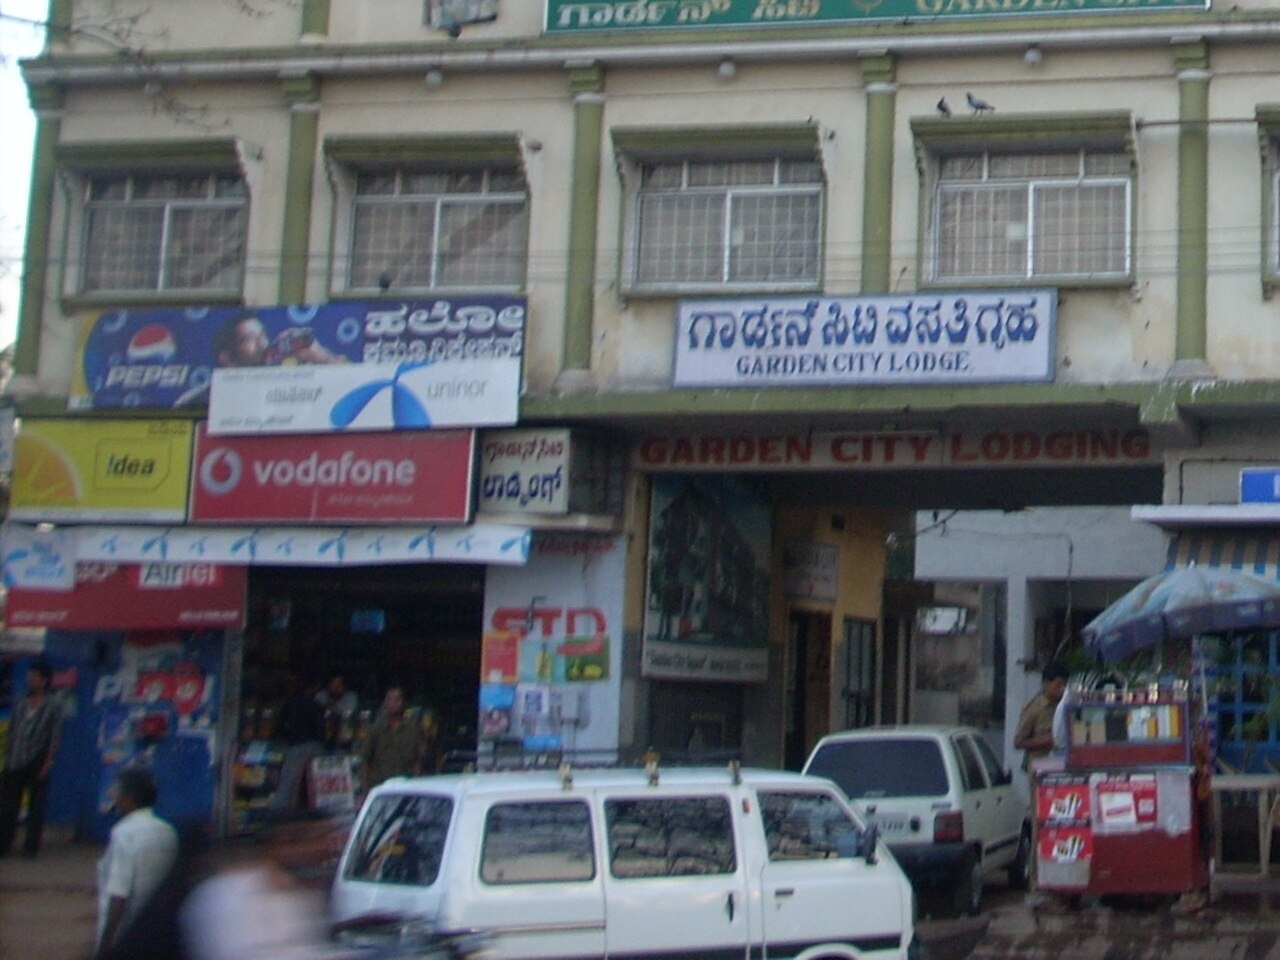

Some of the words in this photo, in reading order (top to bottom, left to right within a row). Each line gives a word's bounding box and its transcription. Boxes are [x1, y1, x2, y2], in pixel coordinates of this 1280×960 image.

[106, 362, 189, 389] PEPSI
[736, 353, 828, 377] GARDEN
[832, 351, 882, 374] CITY
[888, 350, 970, 372] LODGE
[427, 376, 488, 400] uninor
[640, 434, 813, 467] GARDEN
[831, 432, 933, 464] CITY
[948, 426, 1152, 463] LODGING
[253, 452, 416, 487] vodafone
